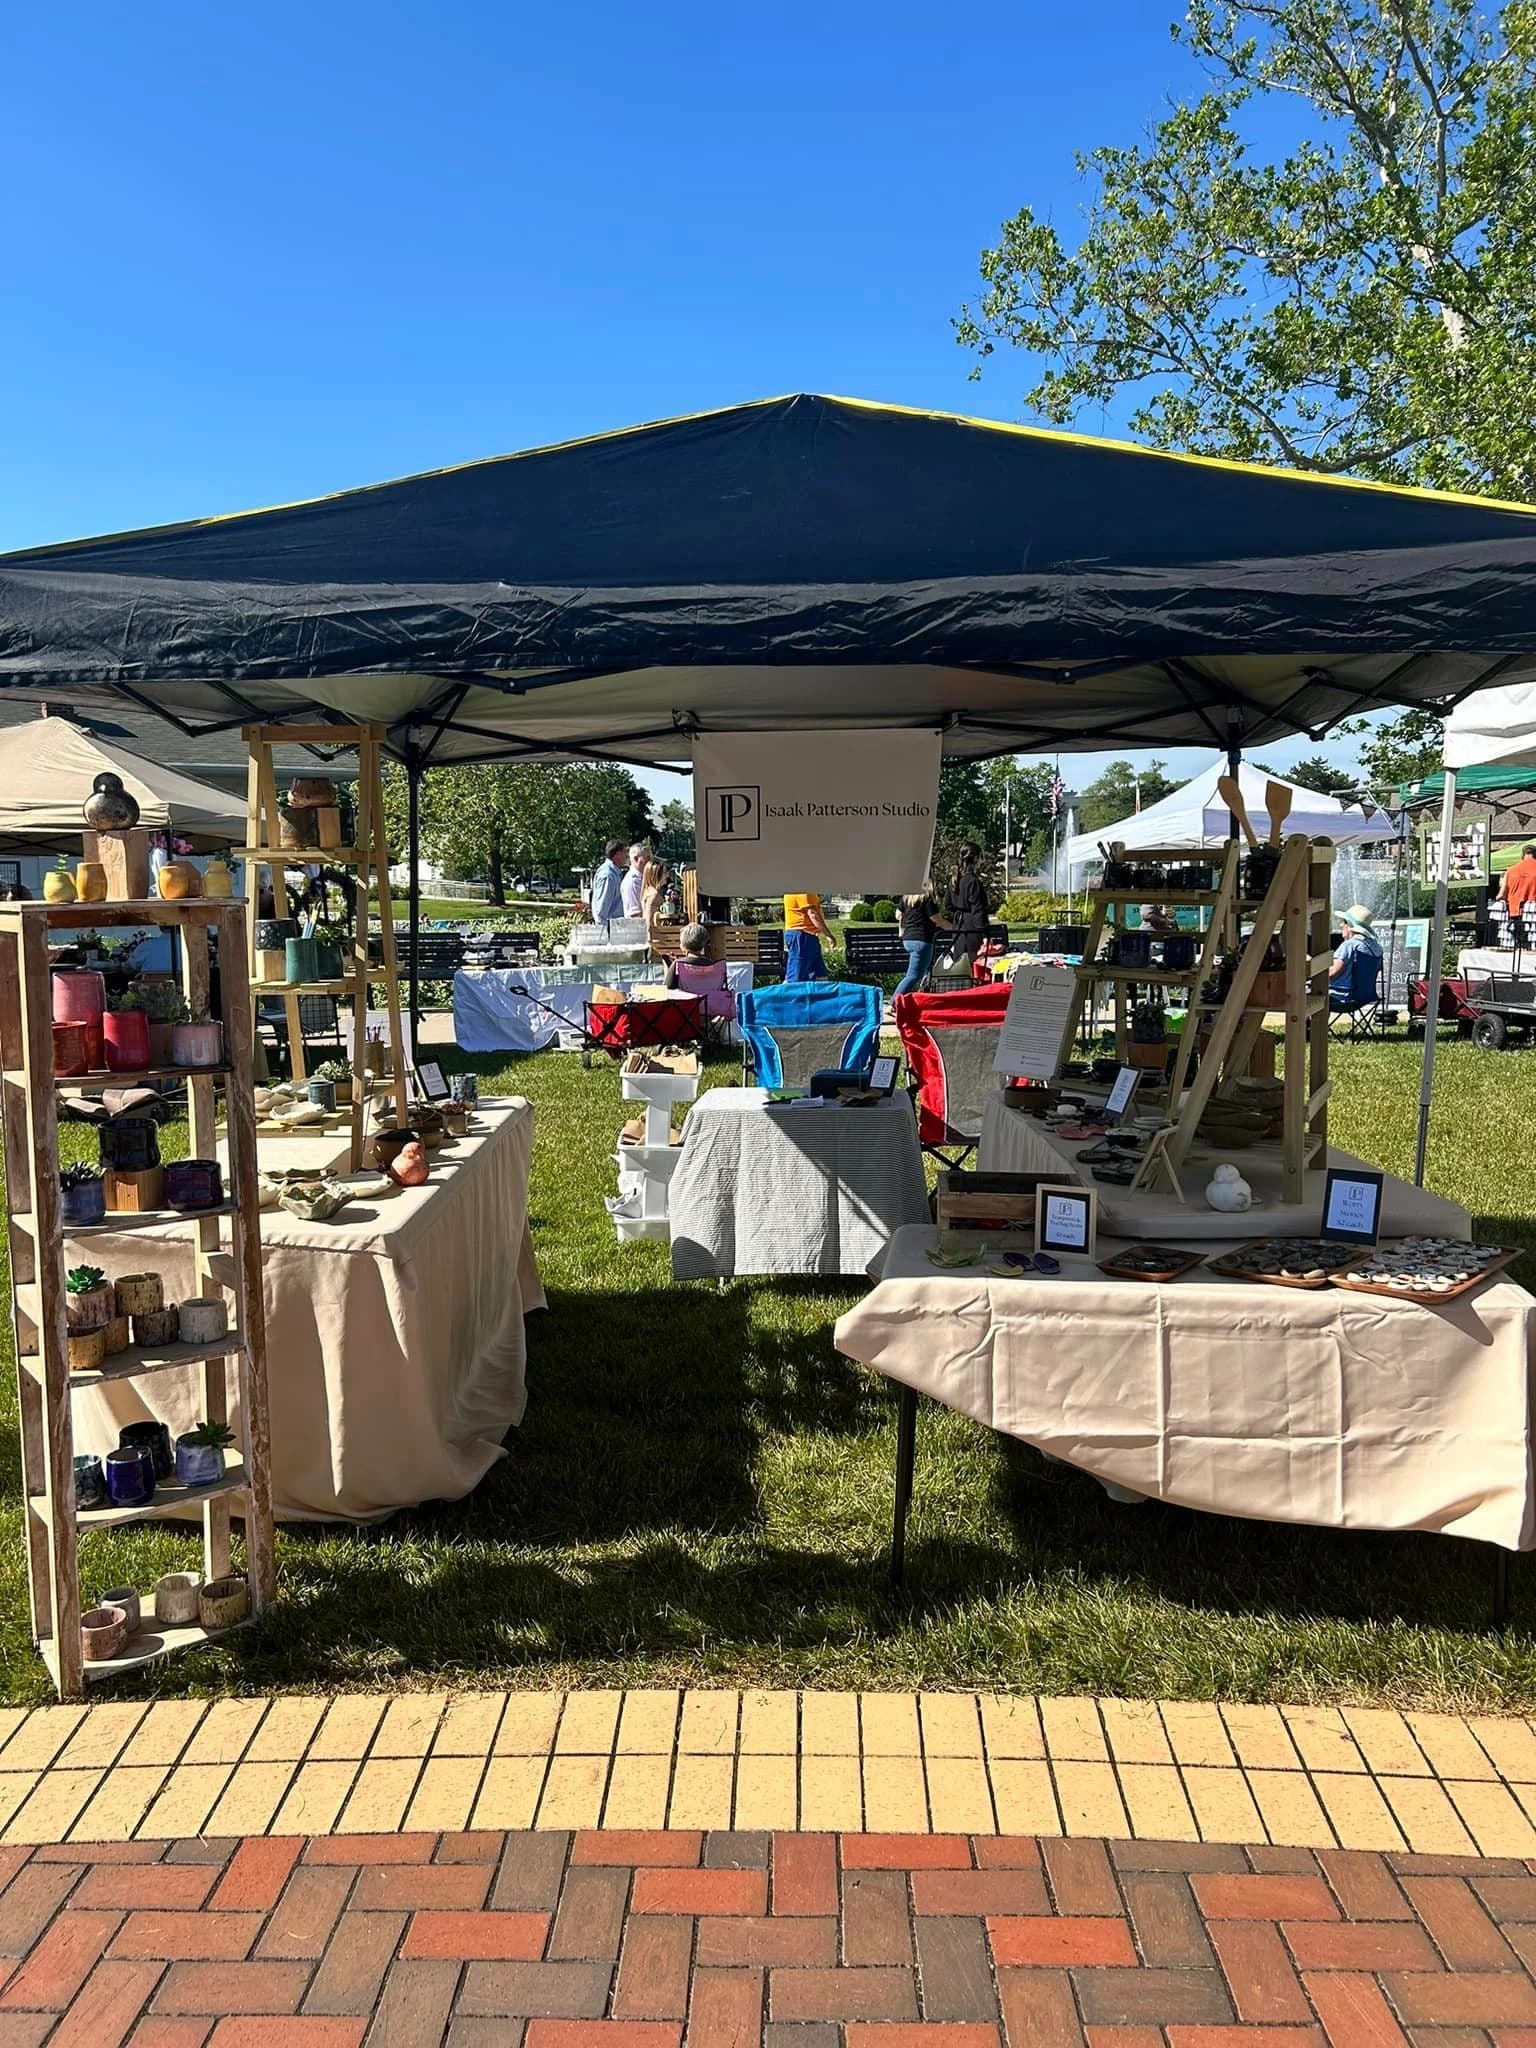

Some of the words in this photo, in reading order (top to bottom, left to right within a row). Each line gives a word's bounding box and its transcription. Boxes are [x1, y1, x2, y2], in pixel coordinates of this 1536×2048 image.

[765, 803, 803, 817] Isaak
[807, 802, 879, 816] Patterson
[882, 801, 930, 816] Studio
